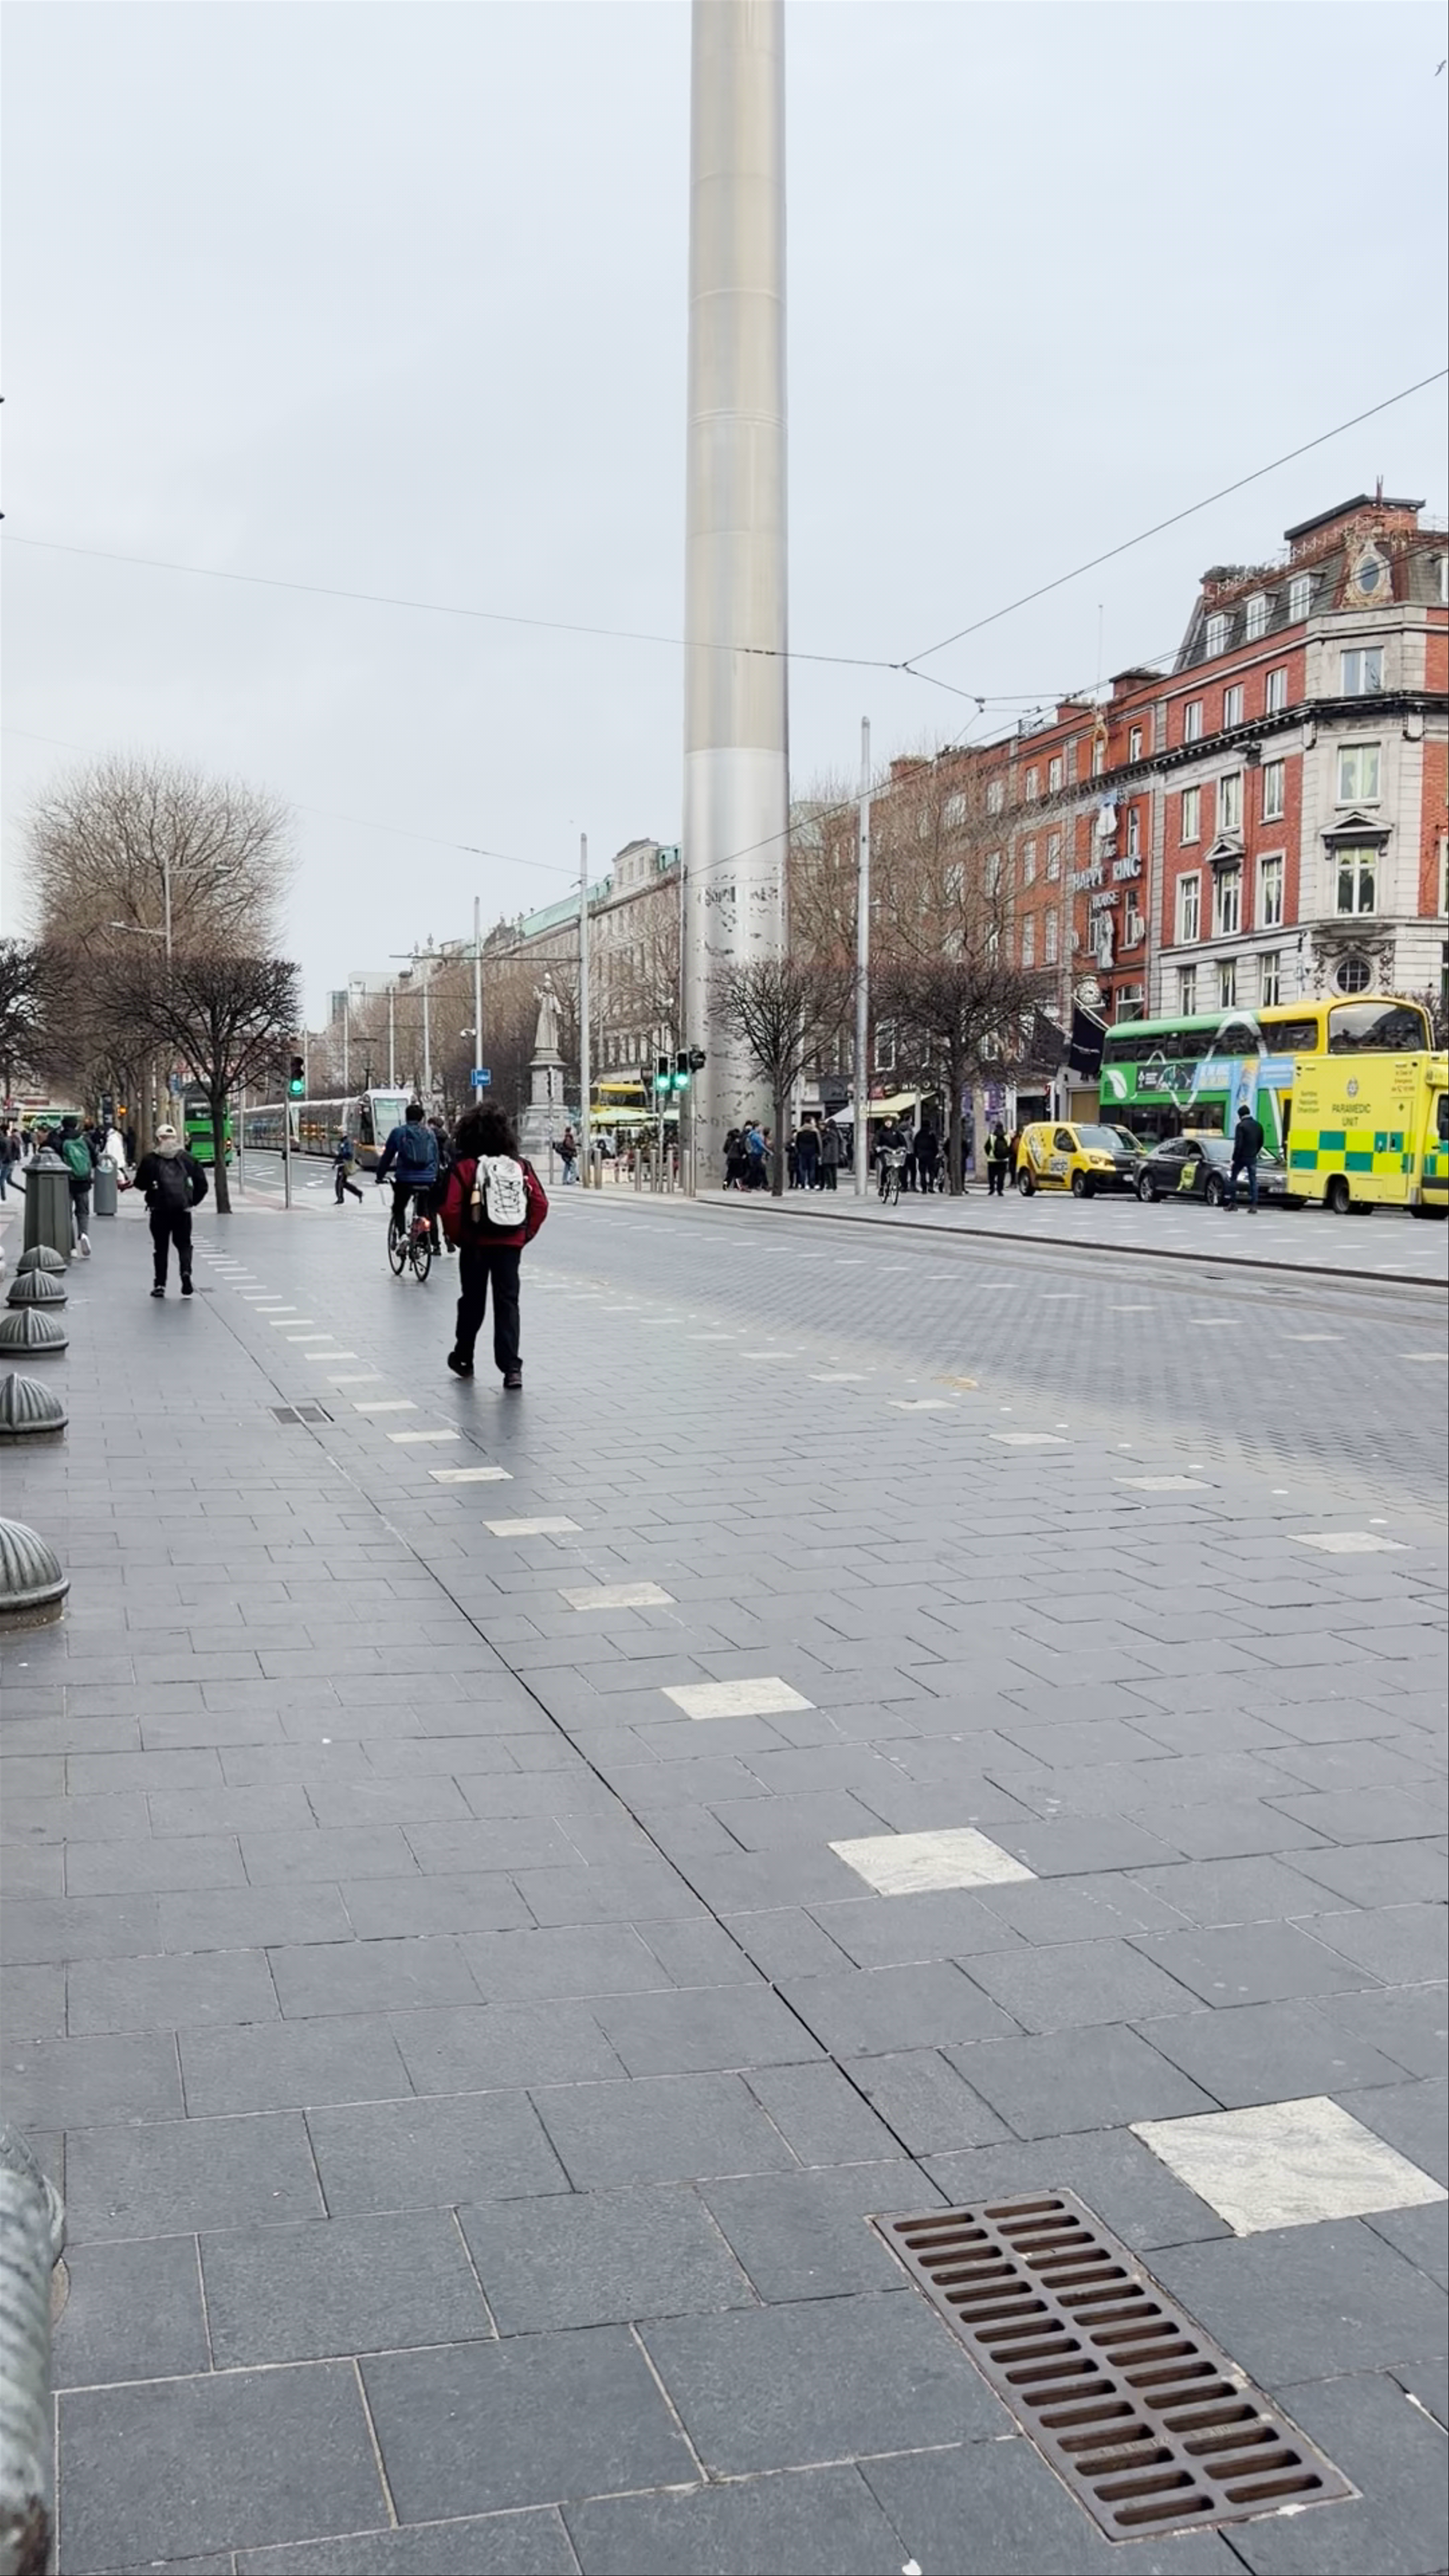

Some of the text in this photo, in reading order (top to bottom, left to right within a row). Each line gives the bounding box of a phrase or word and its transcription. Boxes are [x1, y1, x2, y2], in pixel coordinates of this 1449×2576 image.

[1073, 855, 1141, 891] HAPPY RING
[1332, 1103, 1371, 1113] PARAMEDIC
[1342, 1117, 1358, 1127] UNIT
